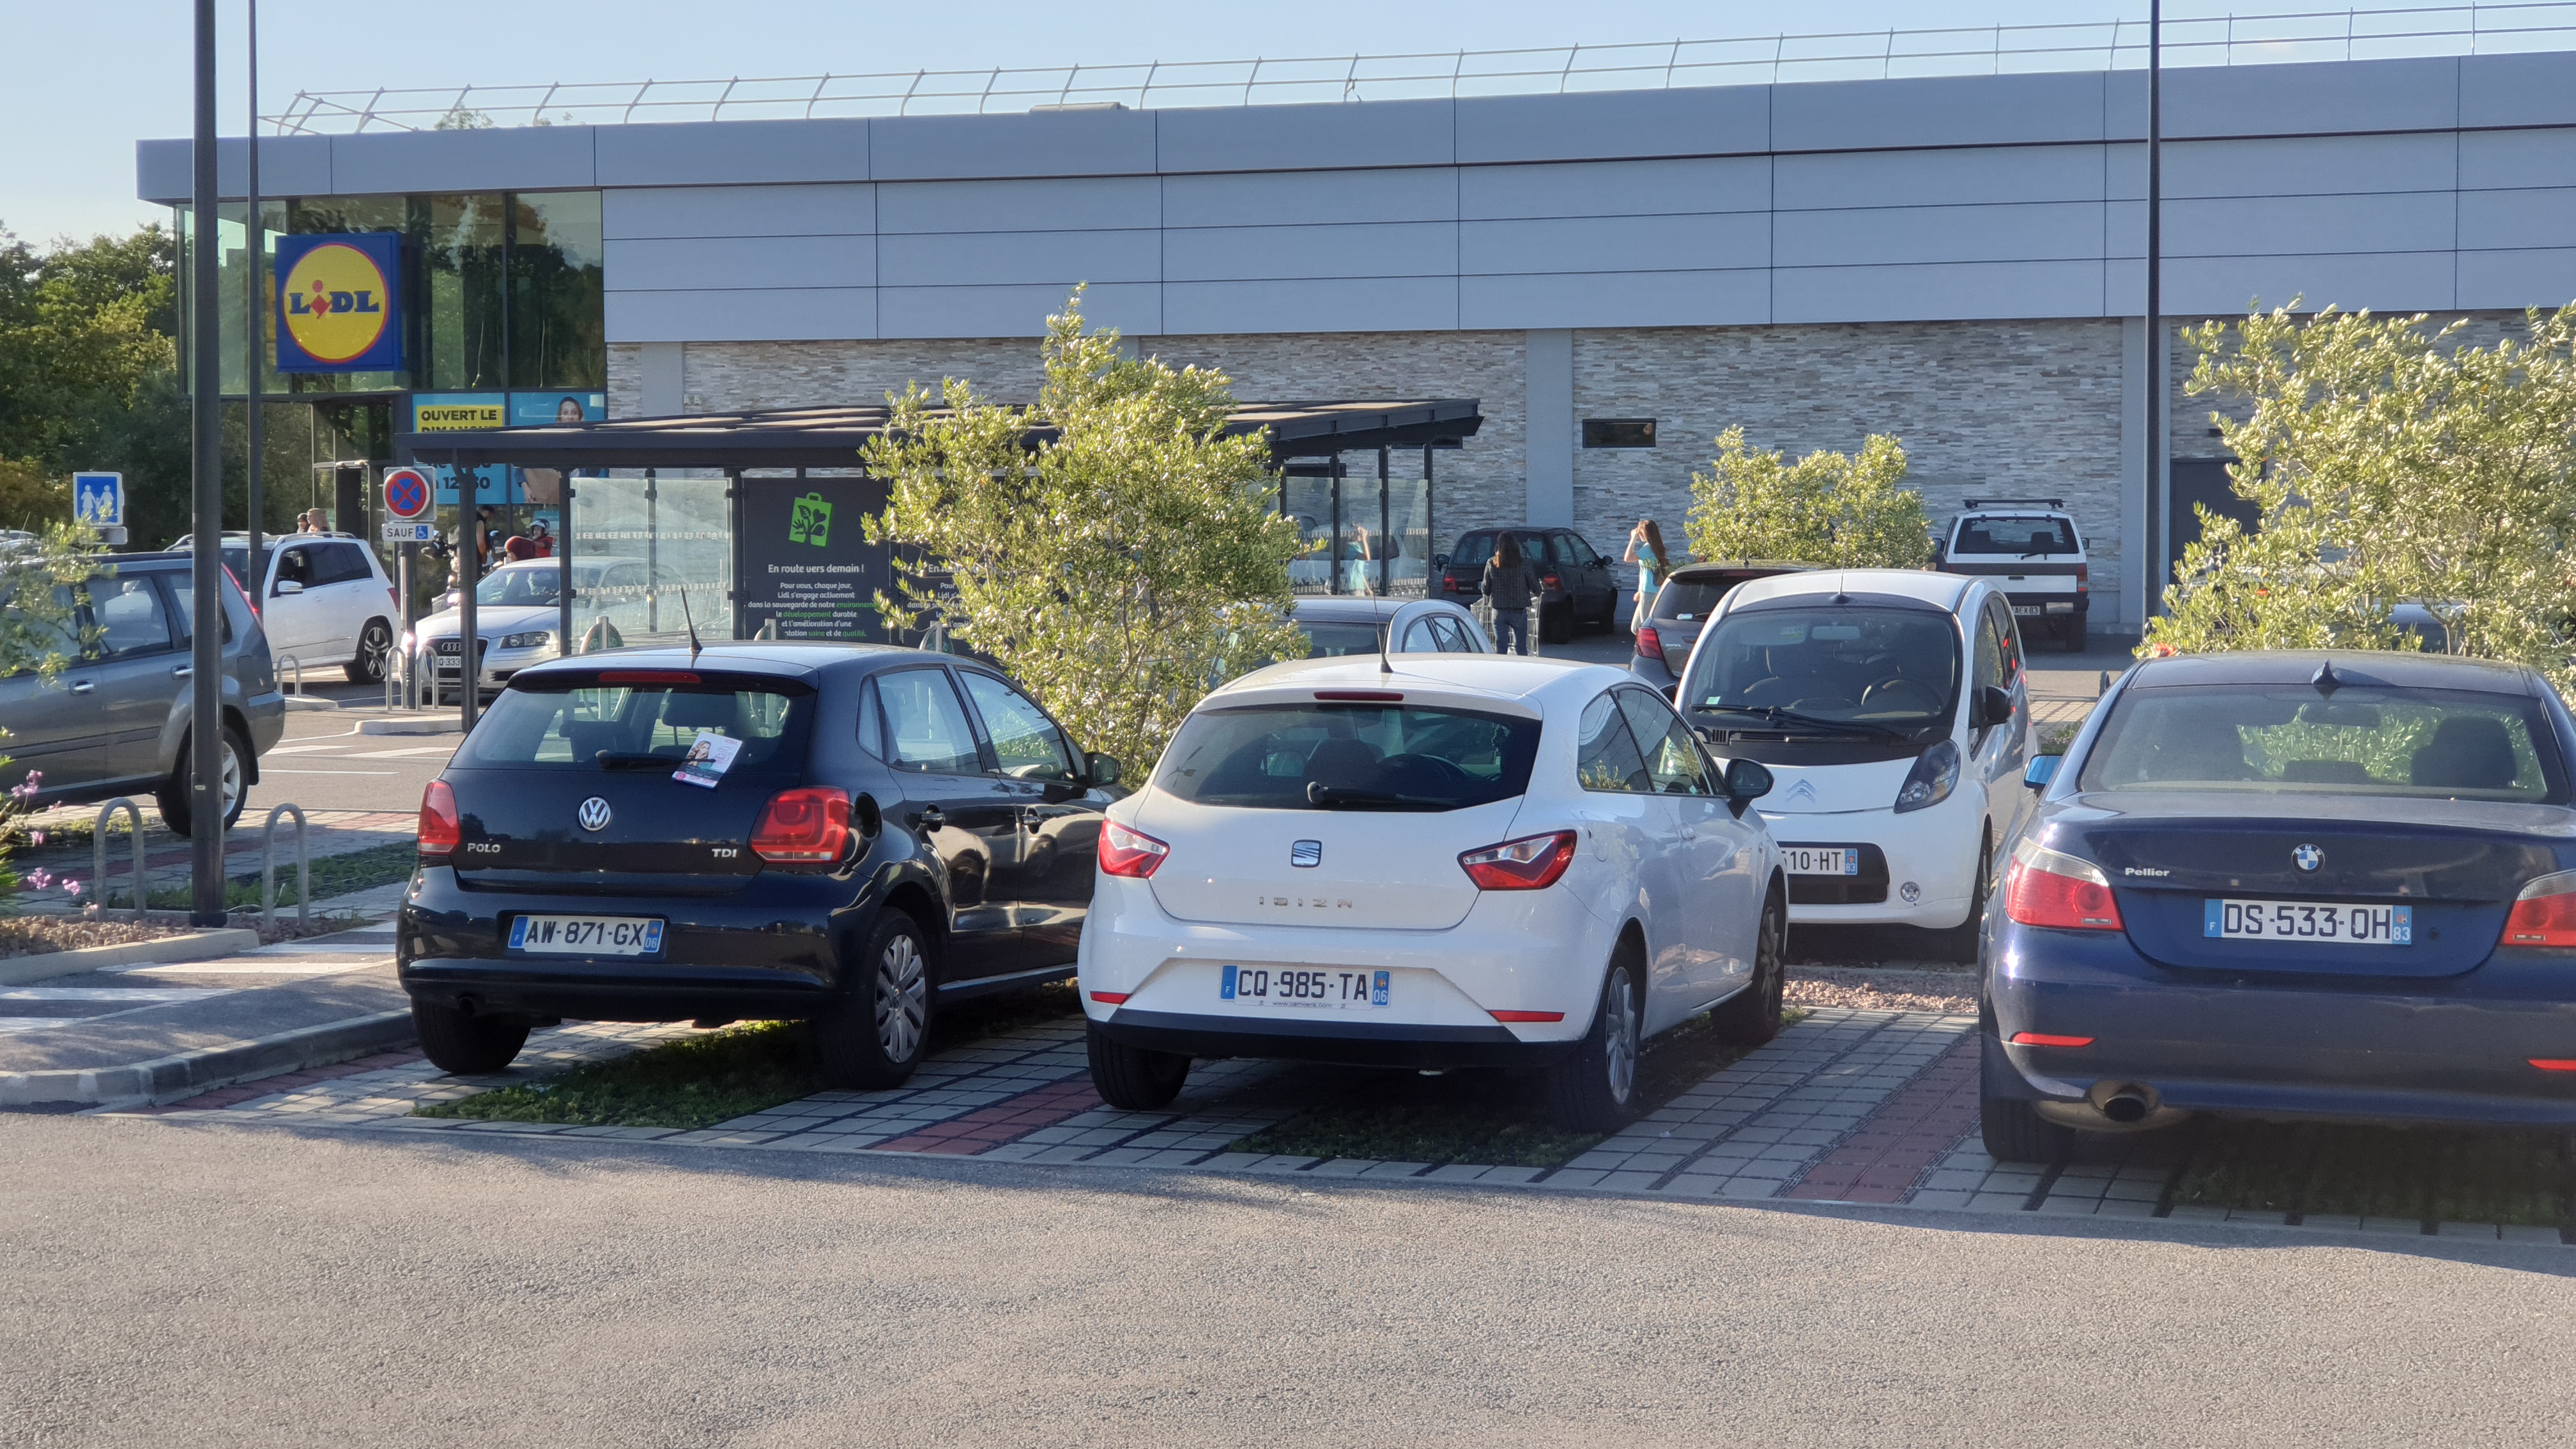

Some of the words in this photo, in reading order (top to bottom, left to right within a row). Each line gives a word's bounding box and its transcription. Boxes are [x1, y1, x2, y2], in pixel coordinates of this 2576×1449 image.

[421, 410, 477, 421] OUVERT
[480, 410, 497, 420] LE
[387, 528, 413, 537] SAUF
[768, 564, 779, 572] En
[781, 564, 804, 572] route
[826, 564, 859, 572] demain
[814, 582, 837, 590] chaque
[838, 582, 852, 590] jour,
[772, 601, 808, 610] sauvegarde
[843, 629, 866, 638] qualité.
[467, 843, 501, 853] POLO
[711, 848, 737, 857] TDI
[1781, 850, 1841, 871] 10-HT
[2125, 868, 2170, 877] Pellier
[2209, 922, 2216, 931] F
[2224, 904, 2391, 940] DS-533-QH
[2393, 926, 2411, 941] 83
[525, 921, 646, 946] AW-871-GX
[645, 937, 657, 948] 06
[1238, 970, 1367, 1000] CQ-985-TA
[1374, 990, 1388, 1002] 06
